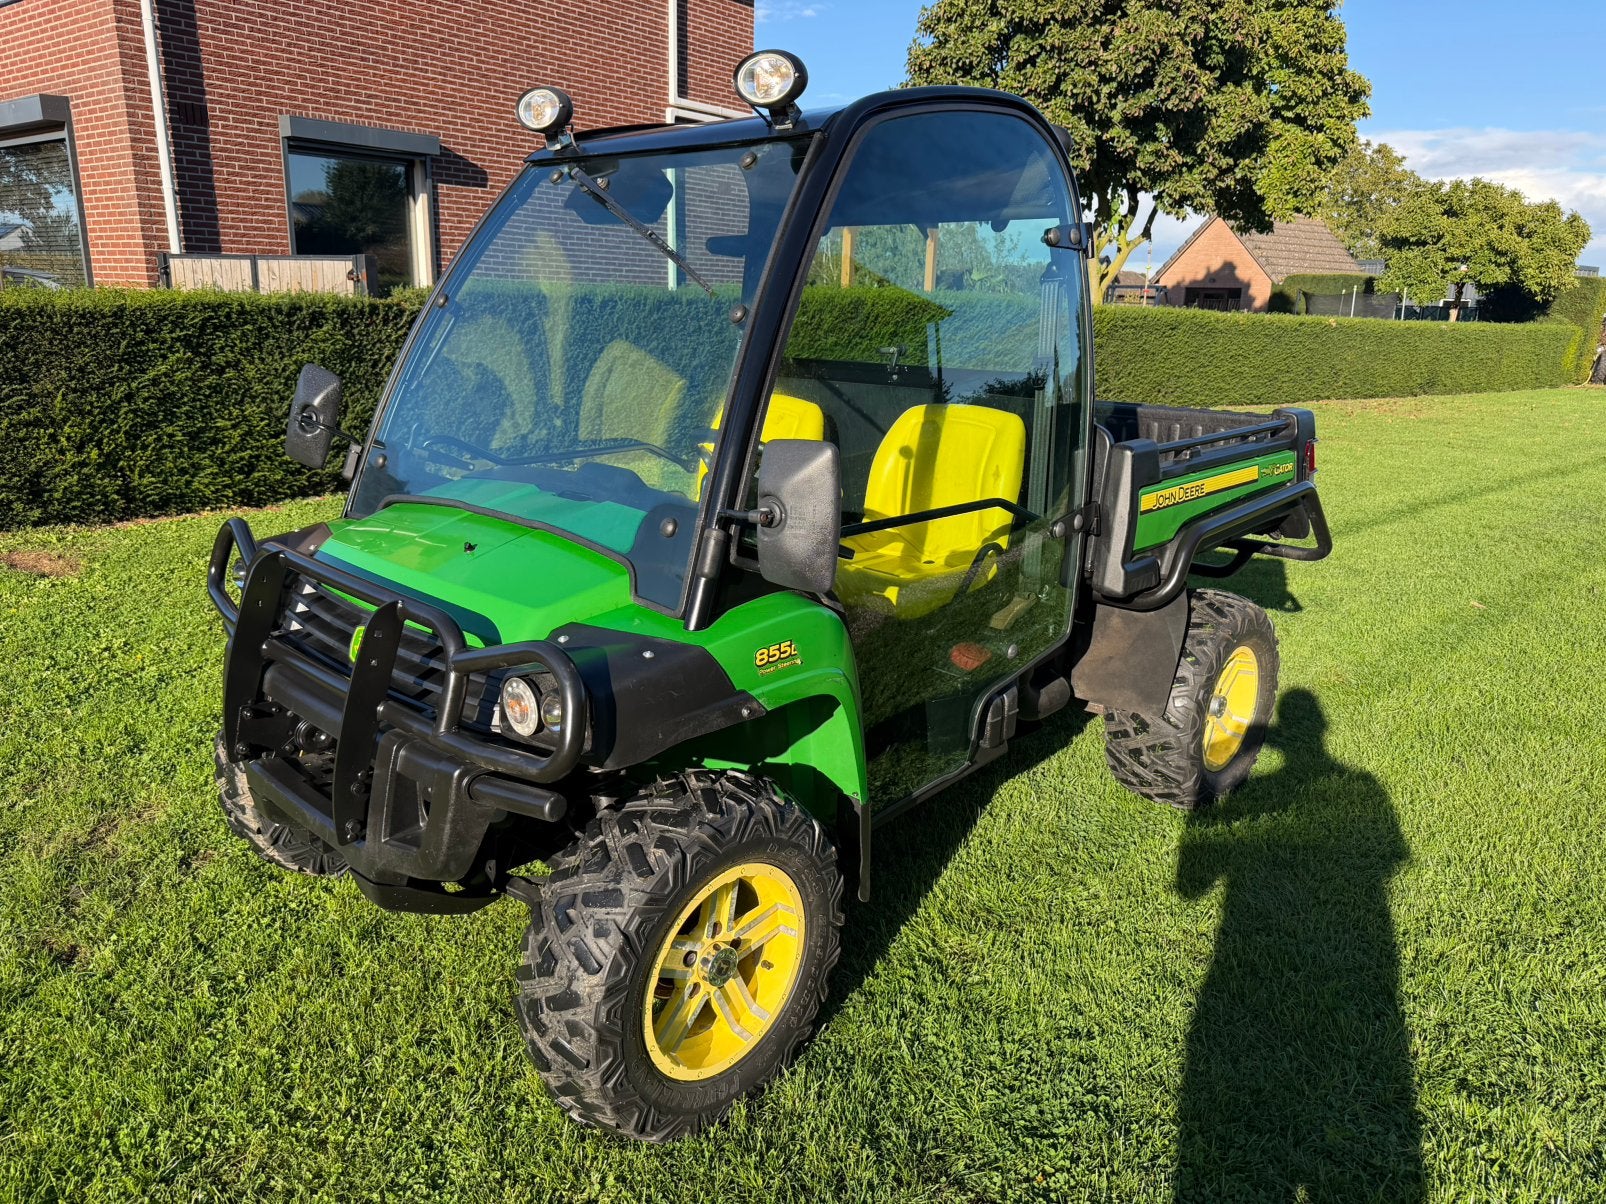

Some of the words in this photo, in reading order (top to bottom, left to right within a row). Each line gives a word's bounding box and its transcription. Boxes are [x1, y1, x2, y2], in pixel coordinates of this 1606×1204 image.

[1274, 463, 1294, 475] GATOR
[1152, 490, 1177, 509] JOHN
[1178, 483, 1206, 502] DEERE
